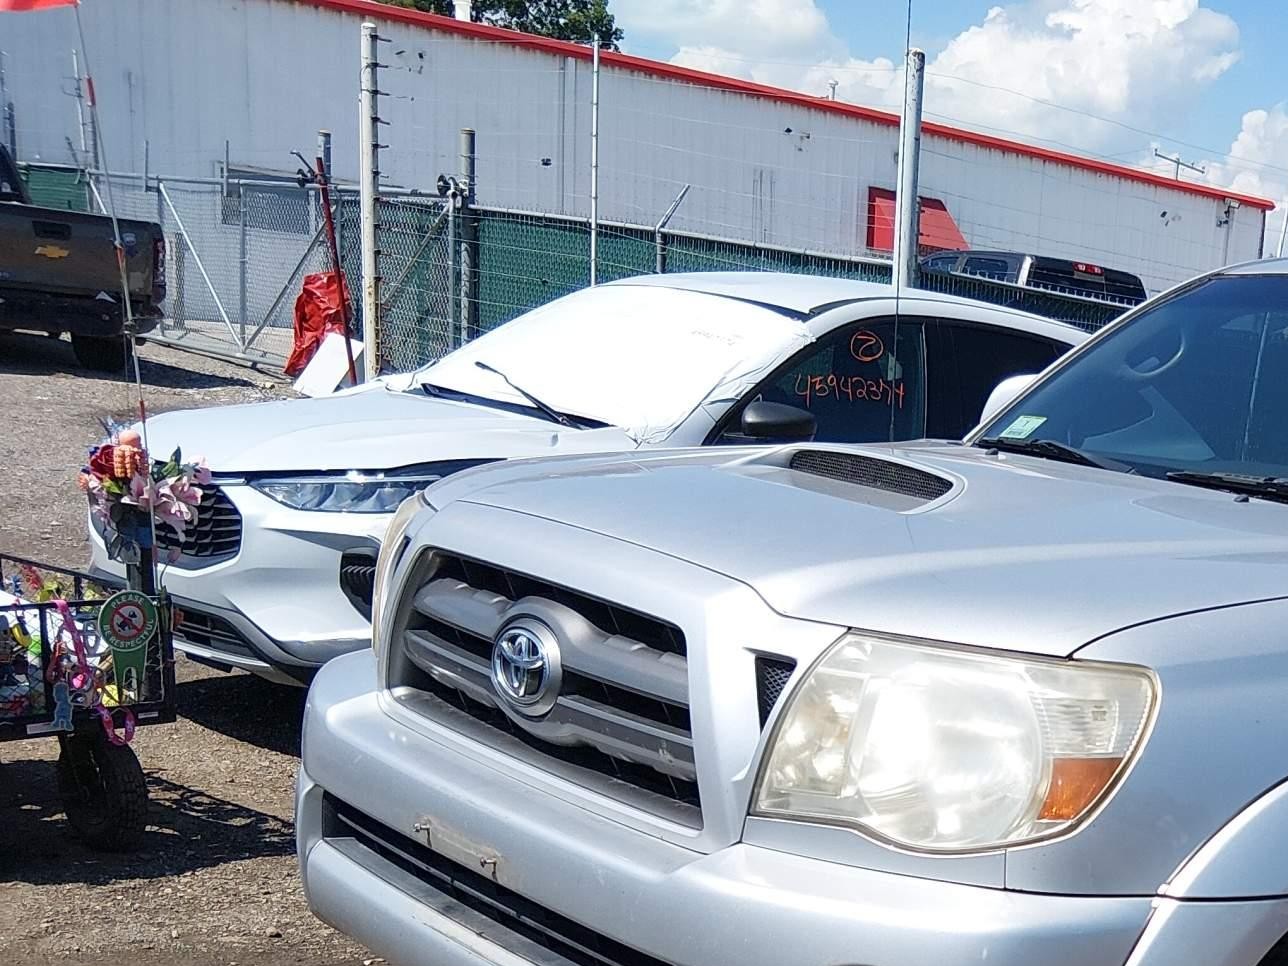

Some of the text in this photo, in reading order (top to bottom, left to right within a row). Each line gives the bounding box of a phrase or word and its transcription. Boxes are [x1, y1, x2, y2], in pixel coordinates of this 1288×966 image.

[794, 372, 905, 409] 45942374
[111, 594, 144, 608] PLEASE
[110, 619, 154, 648] RESPECTFUL
